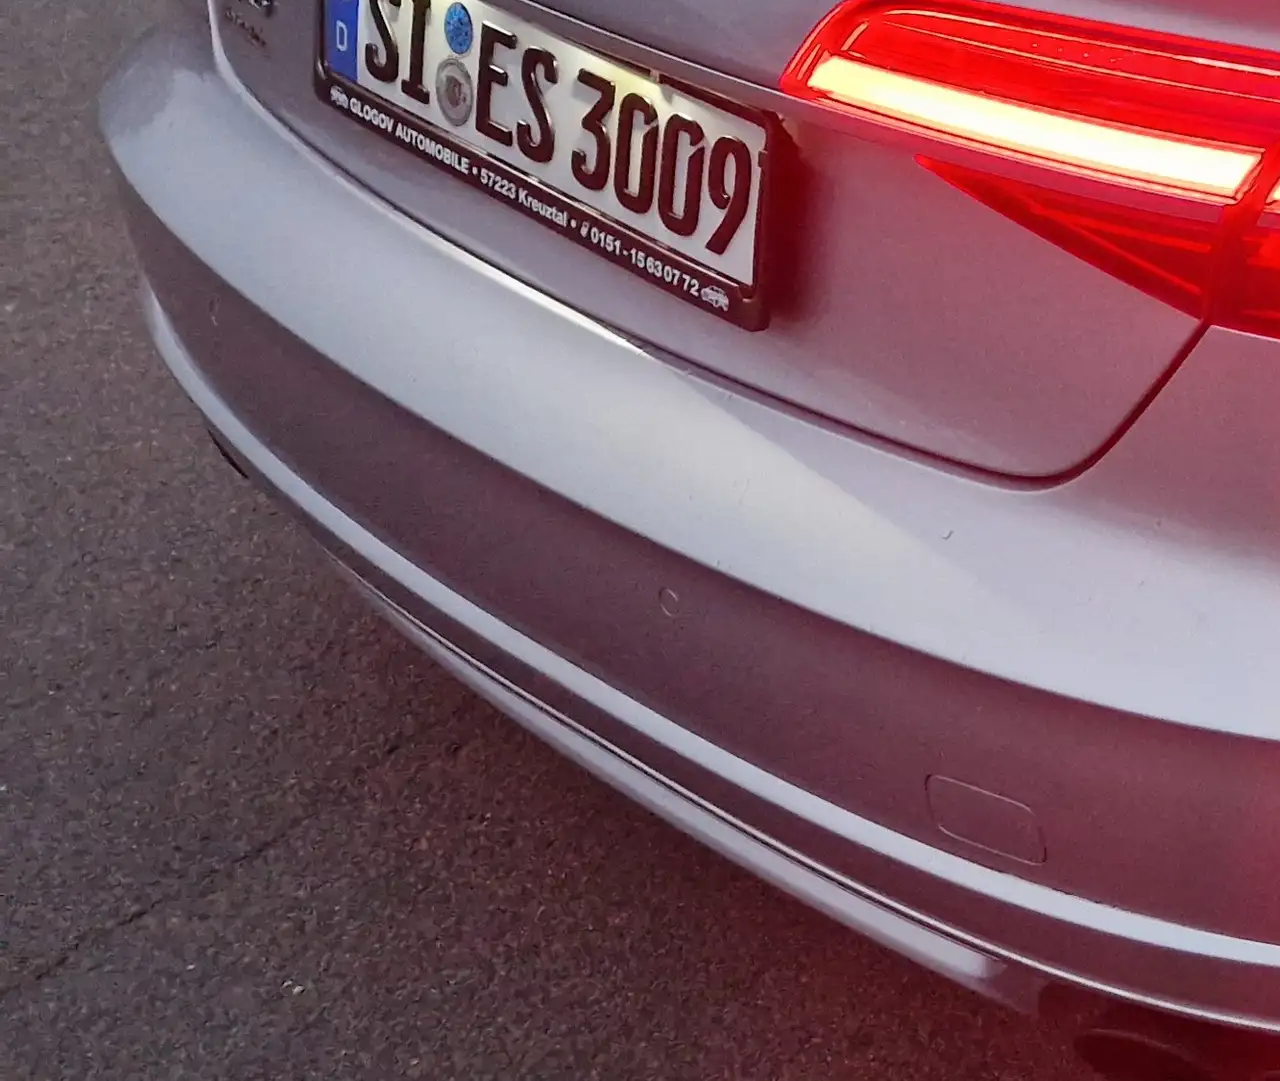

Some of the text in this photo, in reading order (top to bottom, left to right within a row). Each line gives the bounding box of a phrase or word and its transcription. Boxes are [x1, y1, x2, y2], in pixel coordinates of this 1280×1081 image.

[336, 20, 348, 51] D
[350, 97, 394, 133] GLOGOV
[395, 122, 469, 175] AUTOMOBILE
[480, 168, 517, 199] 57223
[518, 187, 568, 227] Kreuztal
[476, 20, 559, 163] ES
[571, 68, 752, 255] 3009
